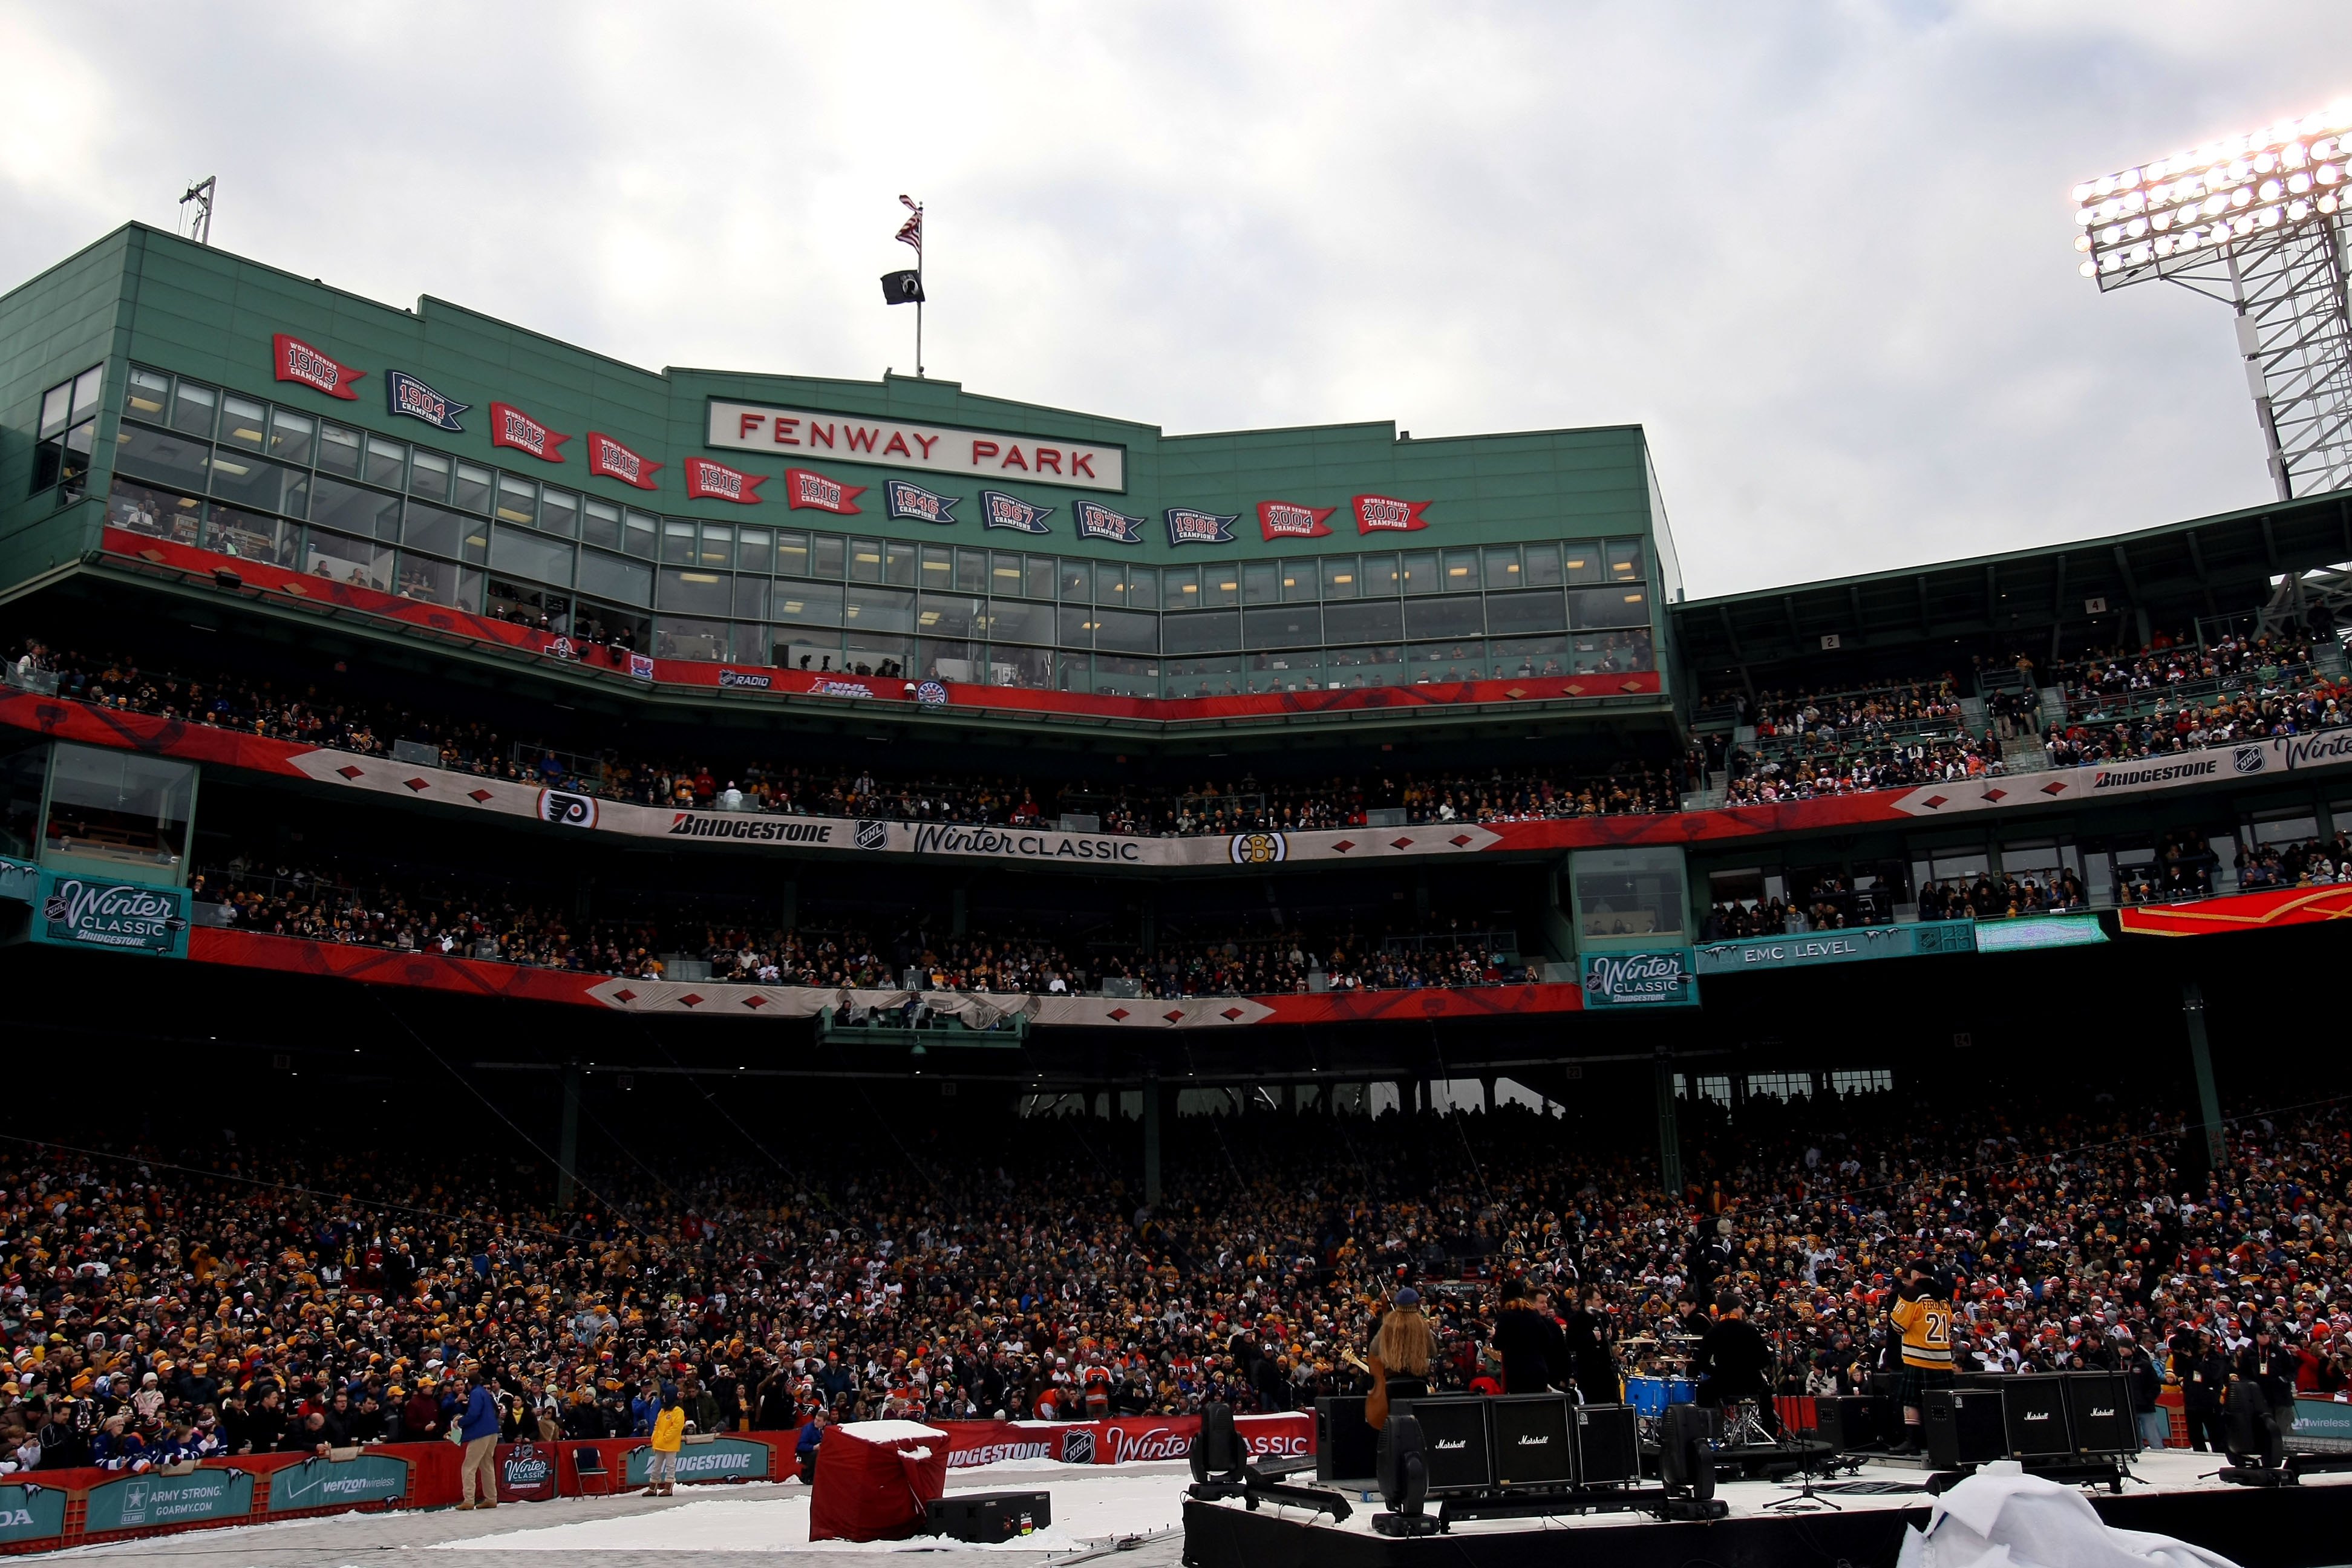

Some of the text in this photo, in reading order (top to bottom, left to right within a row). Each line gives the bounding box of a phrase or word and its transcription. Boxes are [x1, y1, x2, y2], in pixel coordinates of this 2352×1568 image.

[290, 342, 337, 370] WORLD SERIES
[289, 350, 338, 385] 1903
[290, 368, 333, 391] CHAMPIONS
[402, 379, 445, 403] AMERICAN LEAGUE
[400, 385, 445, 419] 1904
[402, 403, 442, 424] CHAMPIONS
[505, 410, 545, 434] WORLD SERIES
[506, 417, 544, 448] 1912
[506, 433, 543, 454] CHAMPIONS
[601, 439, 639, 462] WORLD SERIES
[740, 413, 1095, 478] FENWAY PARK
[603, 446, 638, 476] 1915
[603, 462, 637, 482] CHAMPIONS
[699, 463, 742, 480] WORLD SERIES
[701, 469, 740, 493] 1916
[799, 474, 840, 490] WORLD SERIES
[701, 485, 739, 499] CHAMPIONS
[800, 480, 840, 503] 1918
[897, 486, 938, 500] AMERICAN LEAGUE
[802, 495, 838, 509] CHAMPIONS
[897, 490, 938, 514] 1946
[993, 496, 1031, 511] AMERICAN LEAGUE
[900, 506, 936, 520] CHAMPIONS
[992, 500, 1034, 524] 1967
[1108, 512, 1124, 520] LEAGUE
[1269, 511, 1313, 529] 2004
[1362, 504, 1410, 522] 2007
[995, 517, 1031, 530] CHAMPIONS
[1086, 510, 1126, 534] 1975
[1175, 517, 1217, 535] 1986
[1089, 525, 1123, 539] CHAMPIONS
[2092, 600, 2099, 610] 4
[1828, 637, 1834, 647] 2
[736, 676, 769, 686] RADIO
[829, 682, 870, 691] NHL
[920, 683, 944, 695] HOCKEY
[2094, 760, 2216, 788] BRIDGESTONE
[2239, 751, 2259, 768] NHL
[668, 813, 832, 843] BRIDGESTONE
[860, 825, 882, 844] NHL
[904, 822, 1014, 854] Winter
[1018, 837, 1138, 861] CLASSIC
[48, 902, 66, 916] NHL
[61, 880, 174, 929] Winter
[80, 916, 165, 936] CLASSIC
[76, 929, 147, 947] BRIDGESTONE
[1745, 940, 1857, 962] EMC LEVEL
[1594, 954, 1682, 995] Winter
[1613, 981, 1678, 993] CLASSIC
[1613, 993, 1666, 1002] BRIDGESTONE
[1956, 1034, 1969, 1046] 24
[1569, 1068, 1579, 1078] 23
[1925, 1312, 1949, 1343] 21
[2090, 1408, 2115, 1416] Marshall
[1243, 1436, 1308, 1454] ASSIC
[1436, 1439, 1466, 1449] Marshall
[1518, 1435, 1549, 1445] Marshall
[947, 1440, 1089, 1466] IDGESTONE NHL
[505, 1458, 547, 1481] Winter
[150, 1486, 222, 1503] ARMY STRONG.
[156, 1502, 212, 1515] GOARMY.COM
